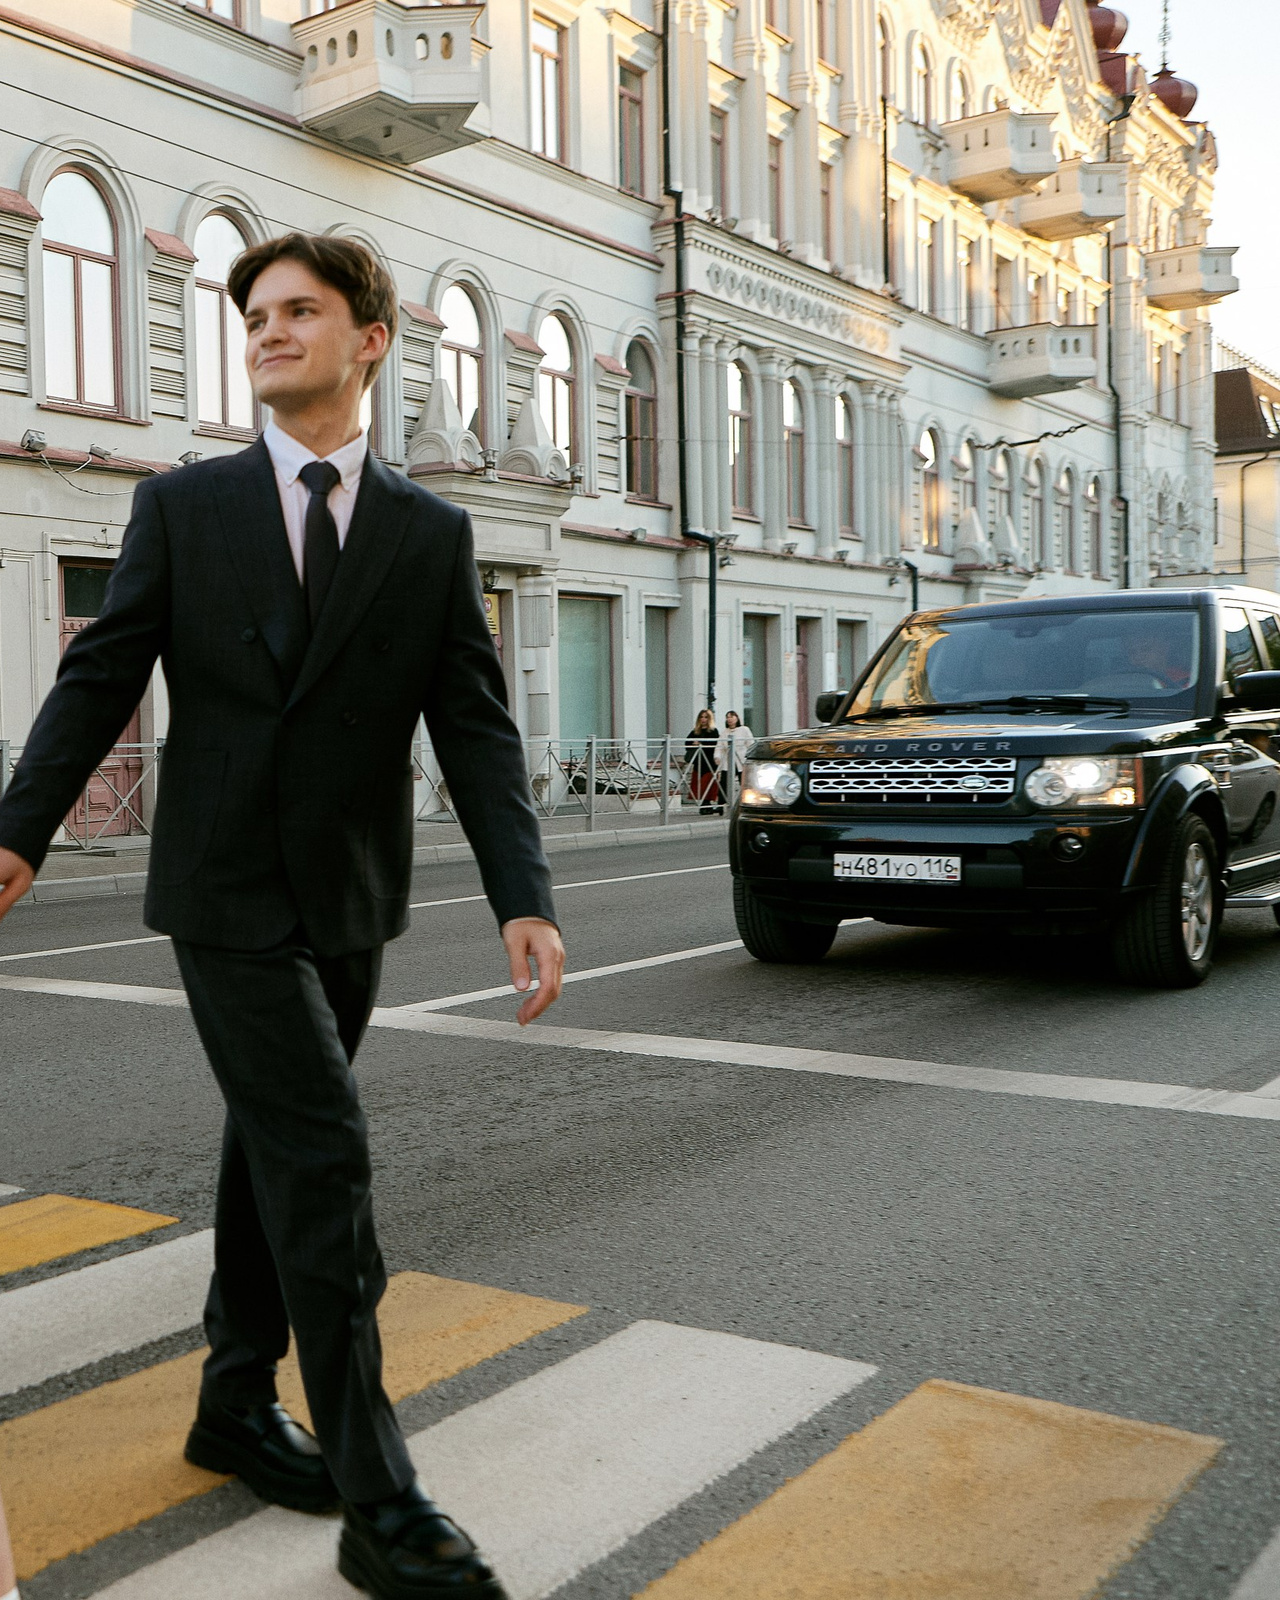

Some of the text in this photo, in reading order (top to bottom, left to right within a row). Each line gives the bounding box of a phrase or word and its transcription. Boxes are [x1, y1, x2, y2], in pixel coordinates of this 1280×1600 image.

[816, 741, 1011, 754] LAND ROVER
[923, 858, 955, 873] 116
